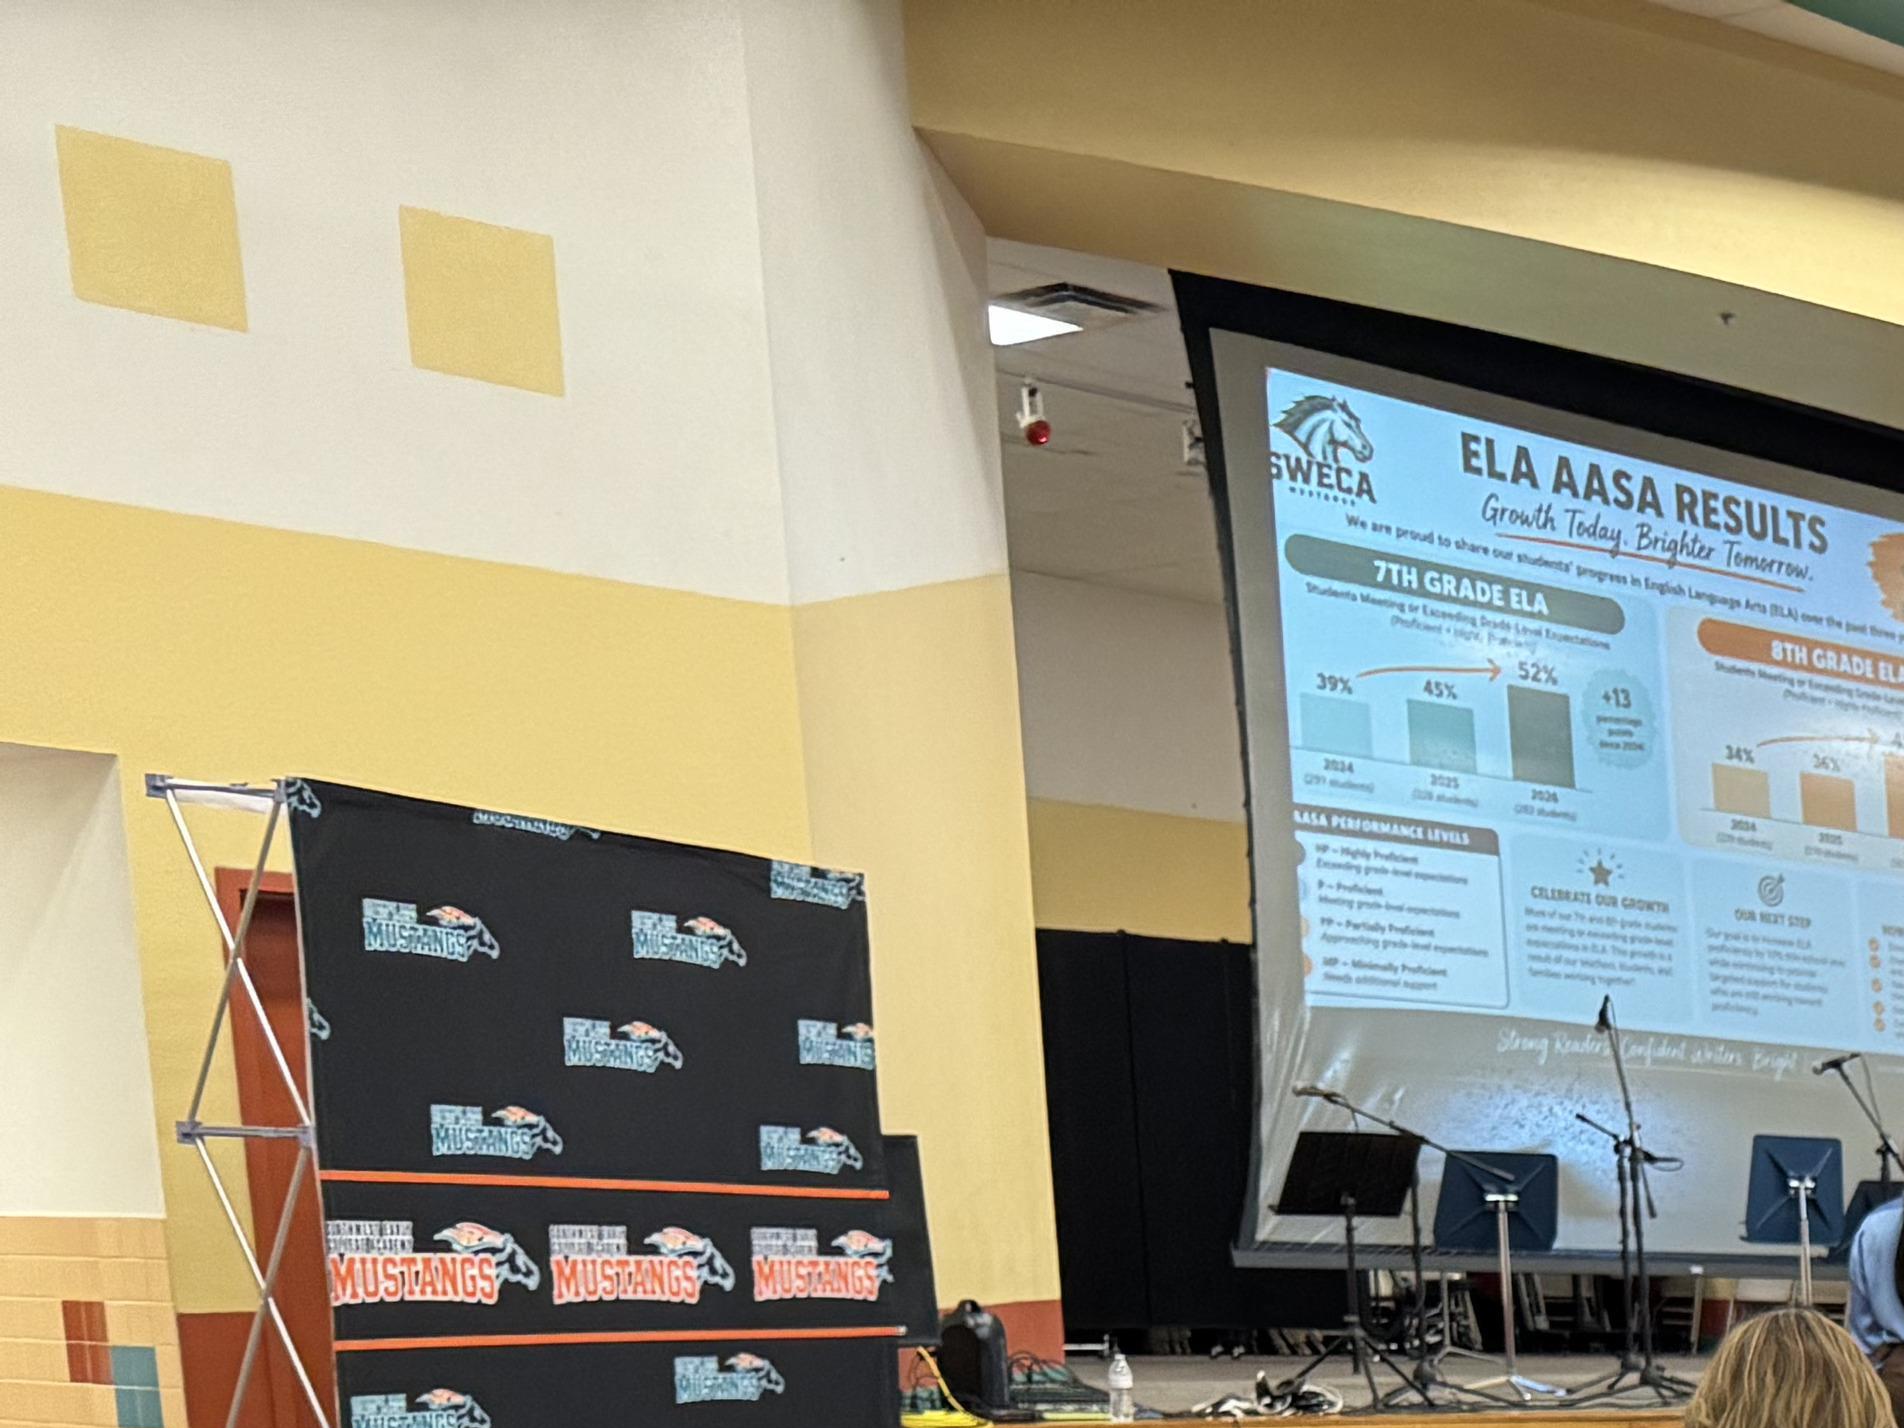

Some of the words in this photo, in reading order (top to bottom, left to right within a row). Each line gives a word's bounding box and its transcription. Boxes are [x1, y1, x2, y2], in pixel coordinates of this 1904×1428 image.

[1460, 430, 1540, 491] ELA
[1550, 452, 1664, 520] AASA
[1674, 482, 1828, 557] RESULTS
[1345, 513, 1367, 533] We
[1394, 523, 1435, 547] proud
[1479, 488, 1556, 539] Growth
[1563, 505, 1629, 561] Today.
[1635, 518, 1717, 578] Brighter
[1722, 536, 1813, 586] Tomorrow.
[1373, 558, 1418, 591] 7TH
[1423, 568, 1504, 608] GRADE
[1509, 585, 1548, 617] ELA
[1517, 661, 1557, 687] 52%
[1770, 638, 1807, 666] 8TH
[1810, 646, 1874, 679] GRADE
[1316, 672, 1352, 695] 39%
[1422, 679, 1457, 701] 45%
[366, 921, 468, 961] MUSTANGS
[432, 1124, 533, 1159] MUSTANGS
[331, 1255, 497, 1304] MUSTANGS
[553, 1257, 699, 1303] MUSTANGS
[754, 1257, 879, 1300] MUSTANGS
